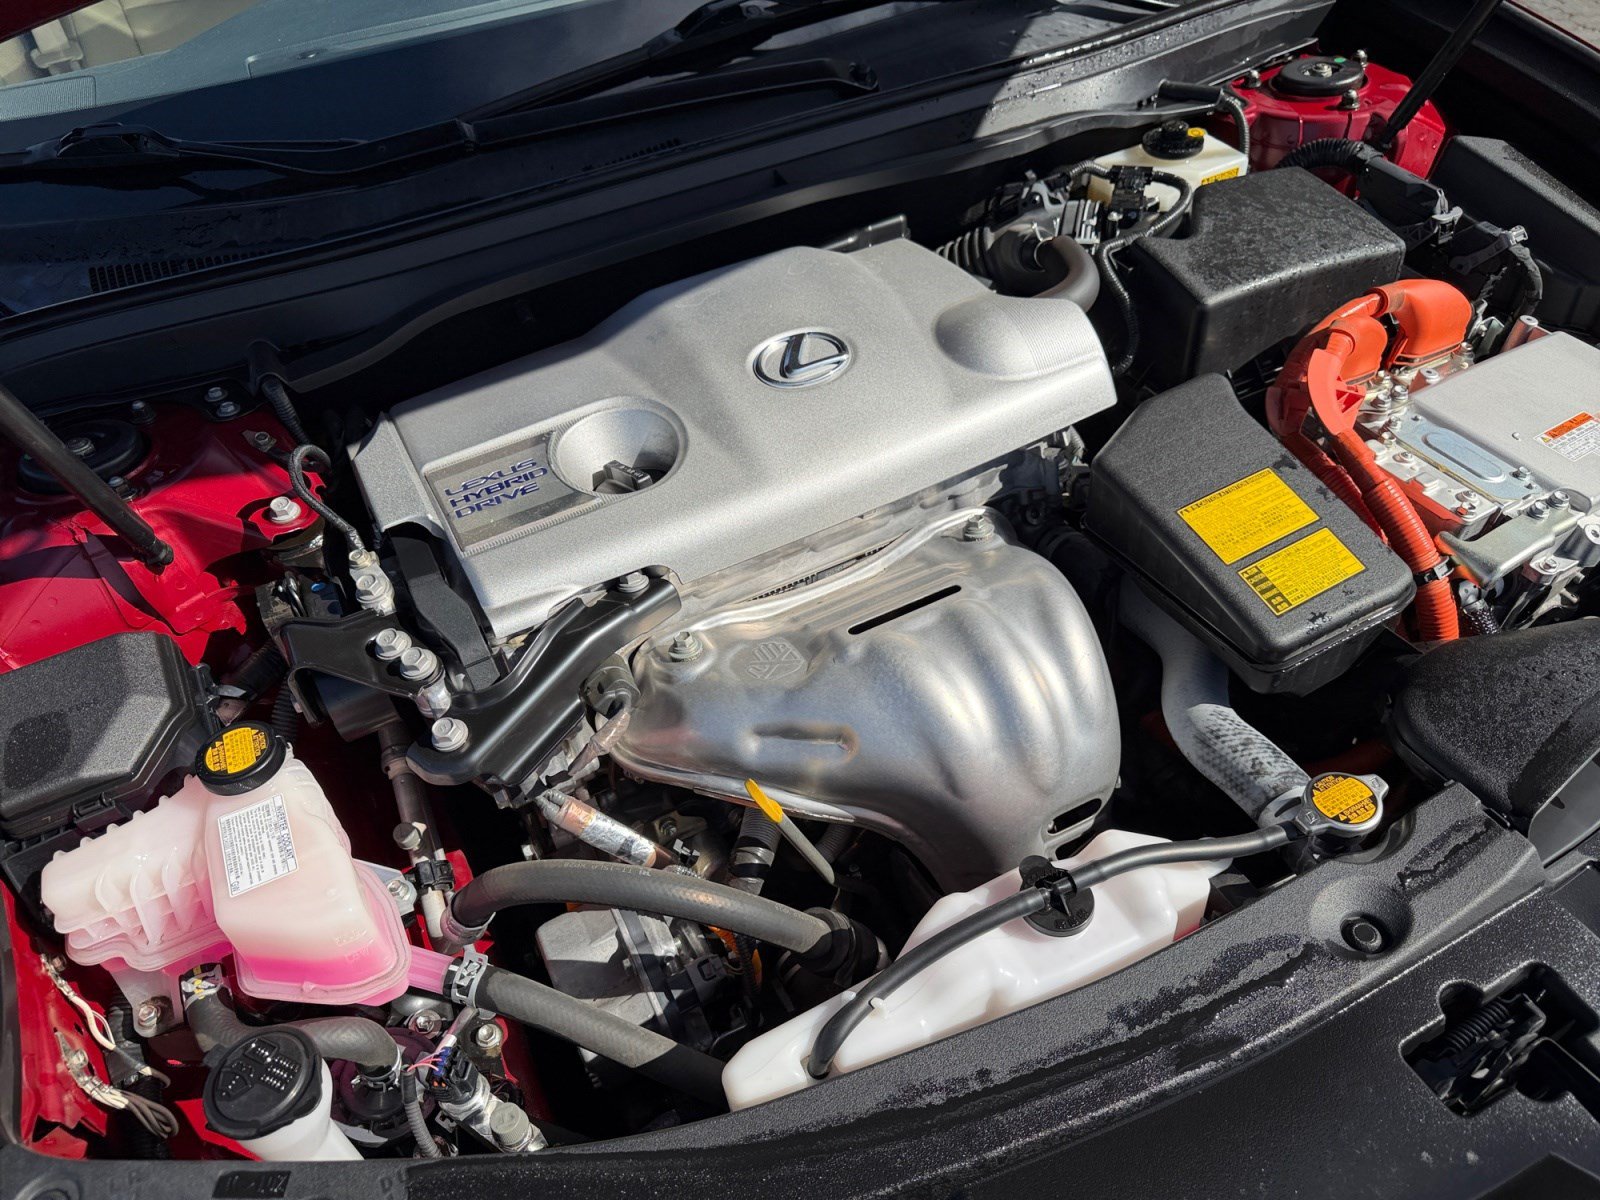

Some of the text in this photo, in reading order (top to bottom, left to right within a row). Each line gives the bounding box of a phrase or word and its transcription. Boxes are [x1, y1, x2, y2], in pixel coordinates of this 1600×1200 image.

[445, 458, 537, 496] LEXUS
[449, 467, 548, 507] HYBRID
[455, 481, 540, 519] DRIVE
[258, 731, 267, 749] CAUTION
[1314, 775, 1335, 788] CAUTION
[1318, 775, 1345, 792] ATTENTION
[275, 805, 295, 860] INVERTER COOLANT
